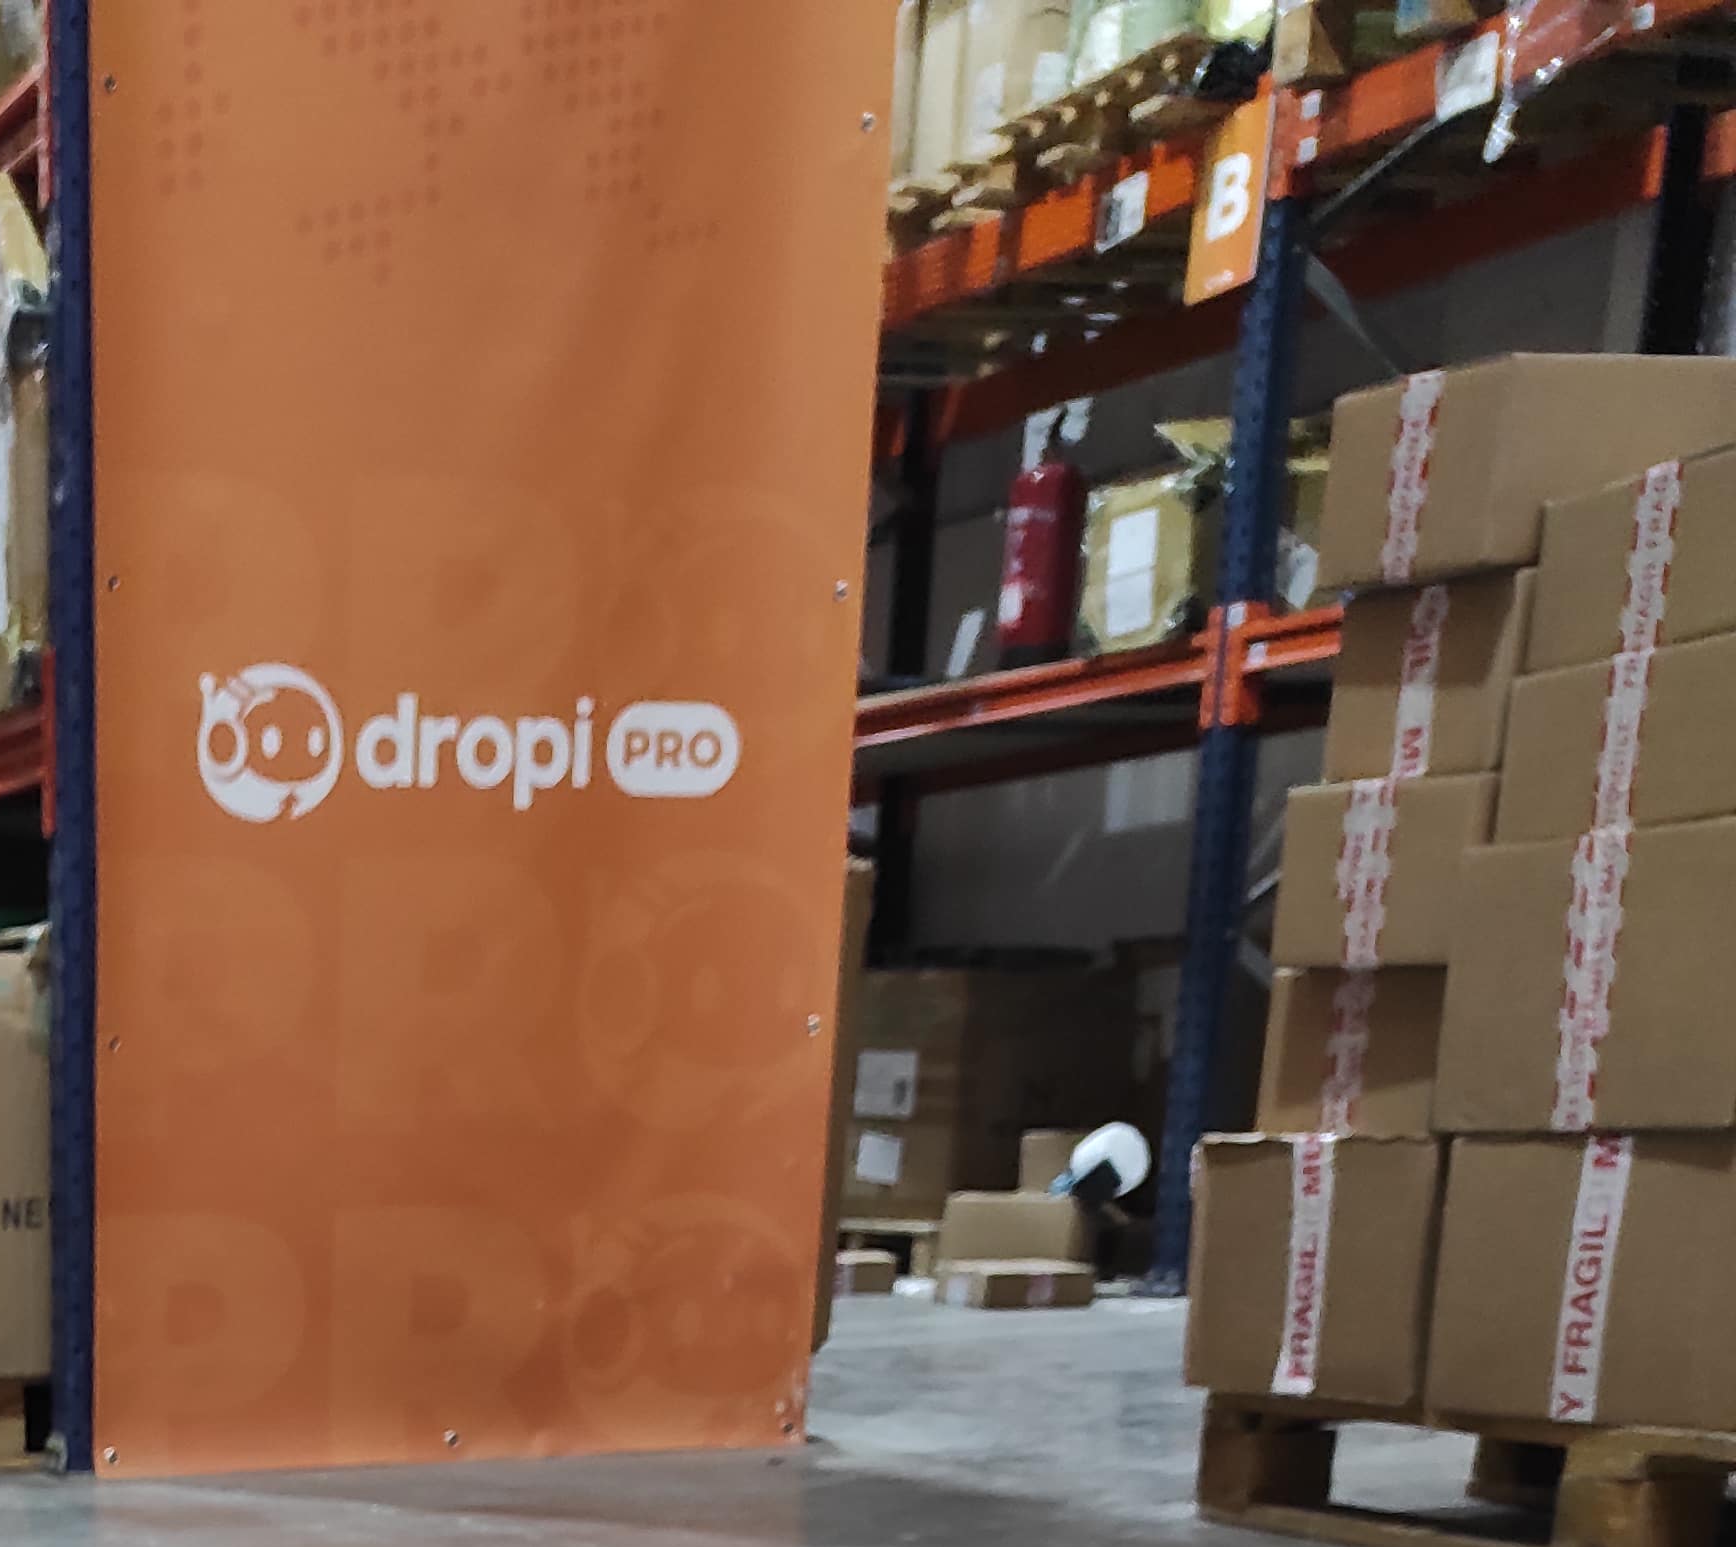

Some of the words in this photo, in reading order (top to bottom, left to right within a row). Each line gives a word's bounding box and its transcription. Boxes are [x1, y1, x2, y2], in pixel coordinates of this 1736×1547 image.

[1205, 152, 1251, 243] B
[355, 691, 594, 812] dropi
[622, 728, 723, 770] PRO
[1, 1197, 53, 1231] NE
[1562, 1213, 1609, 1377] FRAGIL
